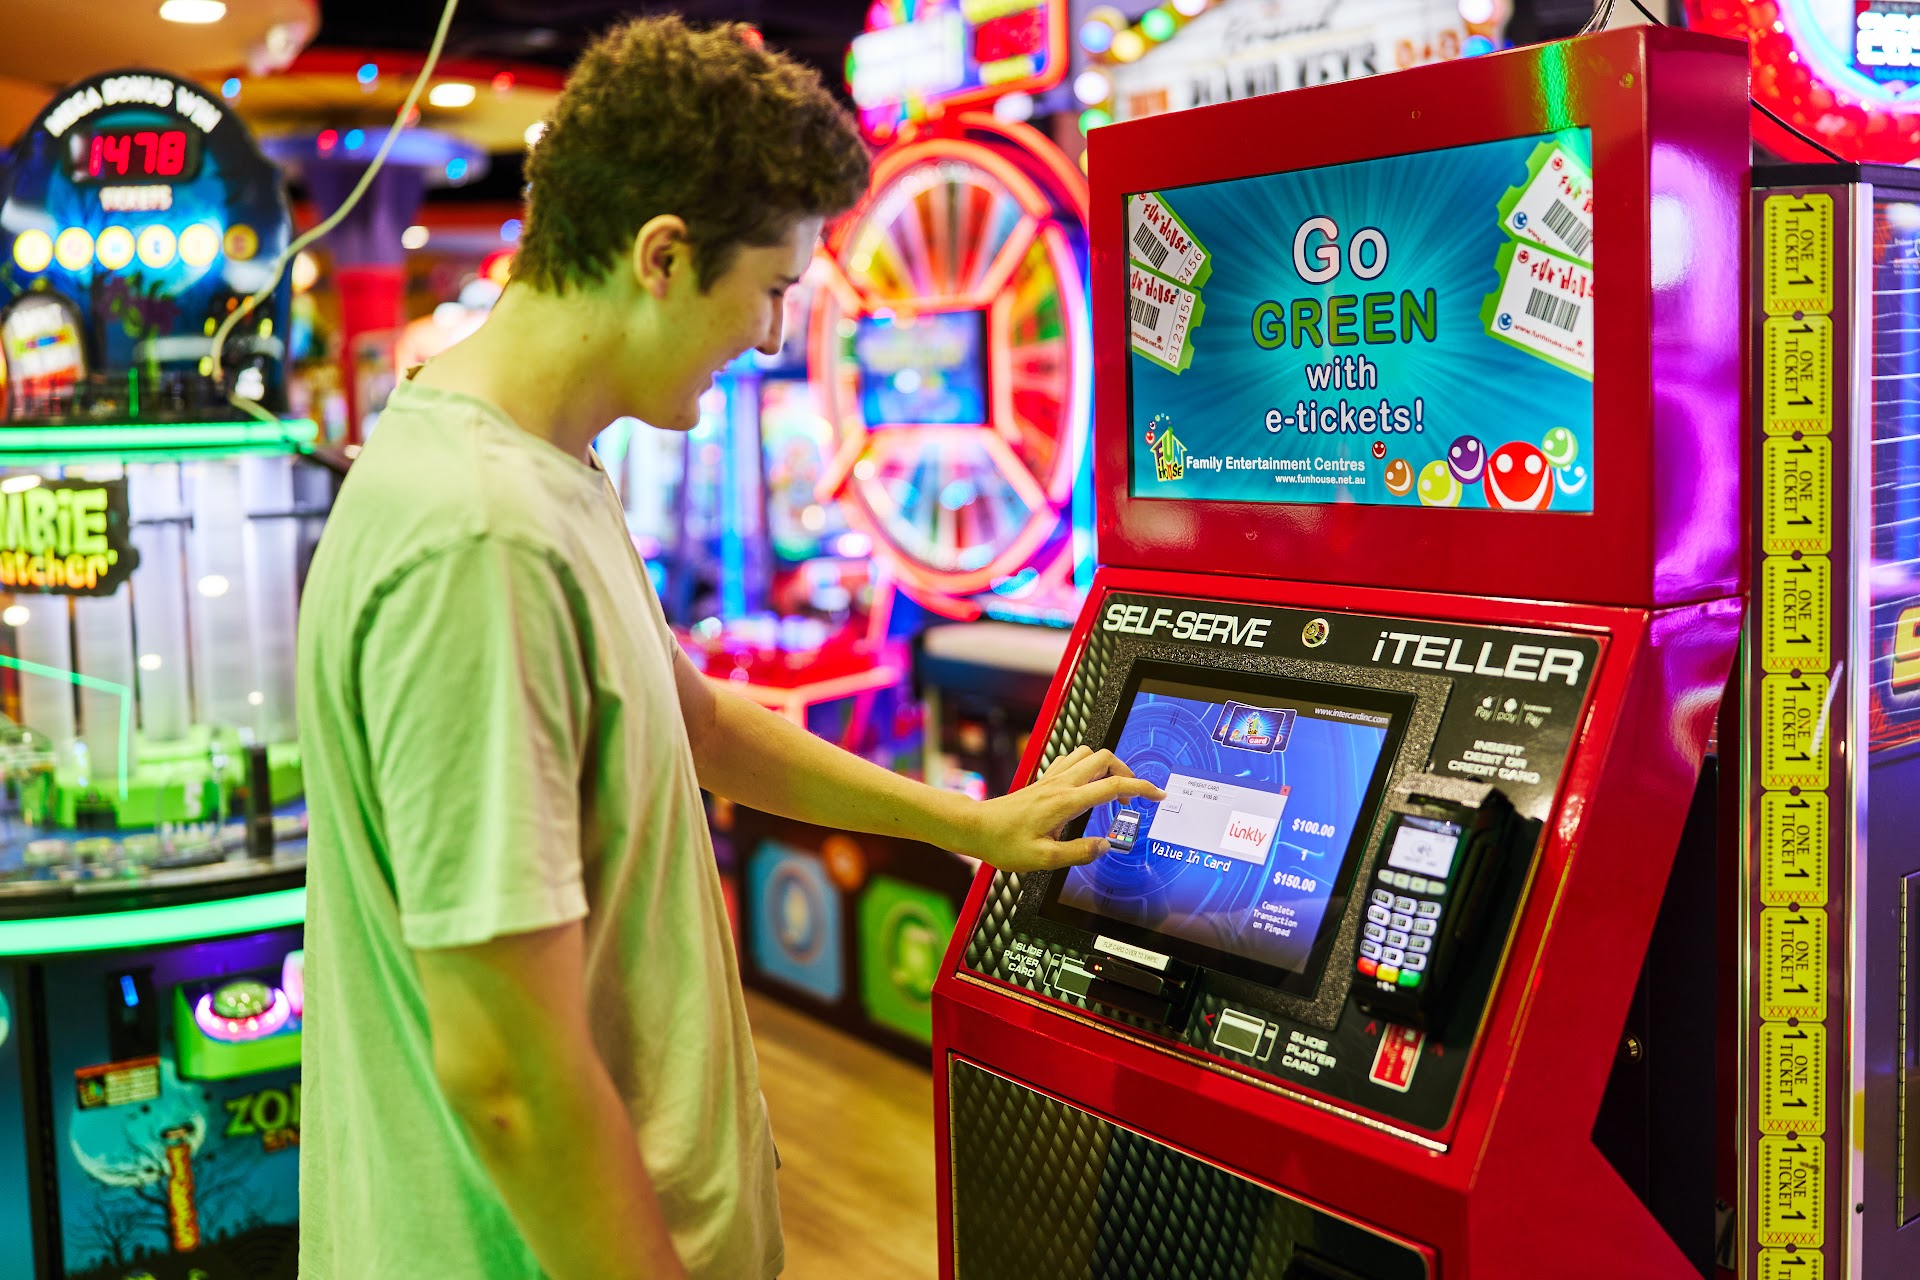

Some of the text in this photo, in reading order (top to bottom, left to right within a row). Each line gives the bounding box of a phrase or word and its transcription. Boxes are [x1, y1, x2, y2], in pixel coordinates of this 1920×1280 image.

[89, 131, 187, 176] 1478
[1788, 203, 1815, 212] 1
[1292, 216, 1389, 284] Go
[1785, 217, 1799, 273] TICKET
[1800, 229, 1814, 260] ONE
[1130, 270, 1143, 291] UN
[1788, 275, 1814, 285] 1
[1168, 293, 1193, 363] S123456
[1252, 287, 1438, 350] GREEN
[1788, 324, 1814, 333] 1
[1306, 354, 1378, 391] with
[1785, 339, 1798, 394] TICKET
[1800, 350, 1813, 381] ONE
[1787, 396, 1813, 405] 1
[1265, 397, 1425, 434] e-tickets!
[1787, 444, 1813, 453] 1
[1186, 455, 1366, 472] Family Entertainment Centres
[1275, 474, 1366, 485] www.funhouse.net.au
[1784, 458, 1797, 514] TICKET
[1799, 470, 1812, 501] ONE
[1787, 516, 1812, 525] 1
[1786, 564, 1812, 573] 1
[1784, 578, 1796, 632] TICKET
[1799, 589, 1811, 620] ONE
[1102, 603, 1585, 687] SELF-SERVE iTELLER
[1786, 634, 1811, 643] 1
[1786, 682, 1811, 691] 1
[1314, 707, 1389, 725] www.intercardinc.com
[1783, 696, 1795, 750] TICKET
[1798, 707, 1810, 738] ONE
[1785, 752, 1811, 761] 1
[1498, 768, 1540, 785] CARD
[1207, 784, 1220, 792] CARD
[1785, 799, 1810, 808] 1
[1229, 821, 1267, 847] linkly
[1292, 818, 1335, 838] $100.00
[1782, 813, 1795, 867] TICKET
[1797, 824, 1809, 855] ONE
[1152, 841, 1232, 872] Value In Card
[1273, 871, 1316, 893] $150.00
[1784, 869, 1810, 878] 1
[1253, 909, 1298, 928] Transaction
[1262, 901, 1295, 917] Complete
[1784, 915, 1809, 924] 1
[1252, 921, 1291, 937] on Pinpad
[1003, 949, 1039, 968] PLAYER
[1016, 942, 1043, 957] SLIDE
[1781, 929, 1794, 983] TICKET
[1796, 940, 1809, 970] ONE
[1008, 962, 1035, 978] CARD
[1783, 984, 1809, 993] 1
[1290, 1031, 1329, 1052] SLIDE
[1783, 1030, 1808, 1039] 1
[1281, 1055, 1320, 1077] CARD
[1285, 1042, 1337, 1069] PLAYER
[1780, 1044, 1793, 1097] TICKET
[1795, 1055, 1807, 1085] ONE
[1782, 1098, 1807, 1107] 1
[1782, 1143, 1807, 1152] 1
[1779, 1156, 1792, 1209] TICKET
[1794, 1168, 1806, 1198] ONE
[1781, 1210, 1806, 1219] 1
[1781, 1256, 1806, 1265] 1
